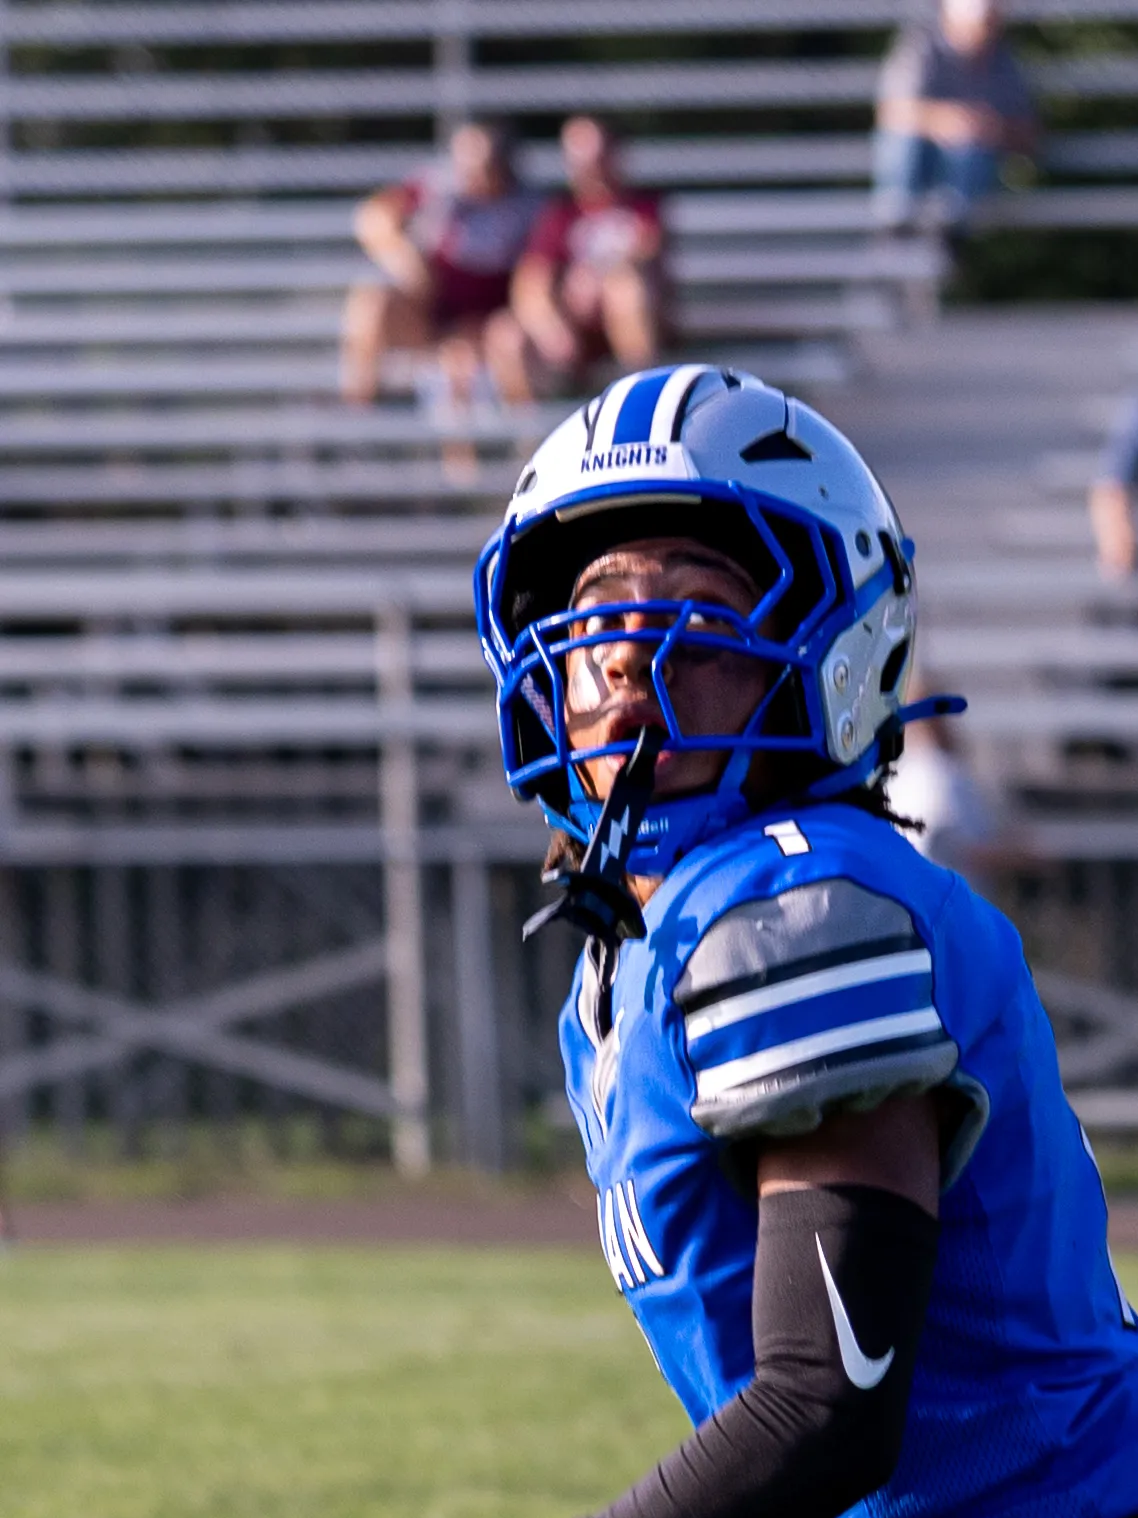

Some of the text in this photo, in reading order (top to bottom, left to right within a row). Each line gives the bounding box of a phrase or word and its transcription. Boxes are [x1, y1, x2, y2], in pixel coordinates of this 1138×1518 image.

[580, 444, 668, 474] KNIGHTS
[638, 817, 670, 836] dell
[763, 818, 812, 857] 1
[596, 1178, 665, 1293] AN
